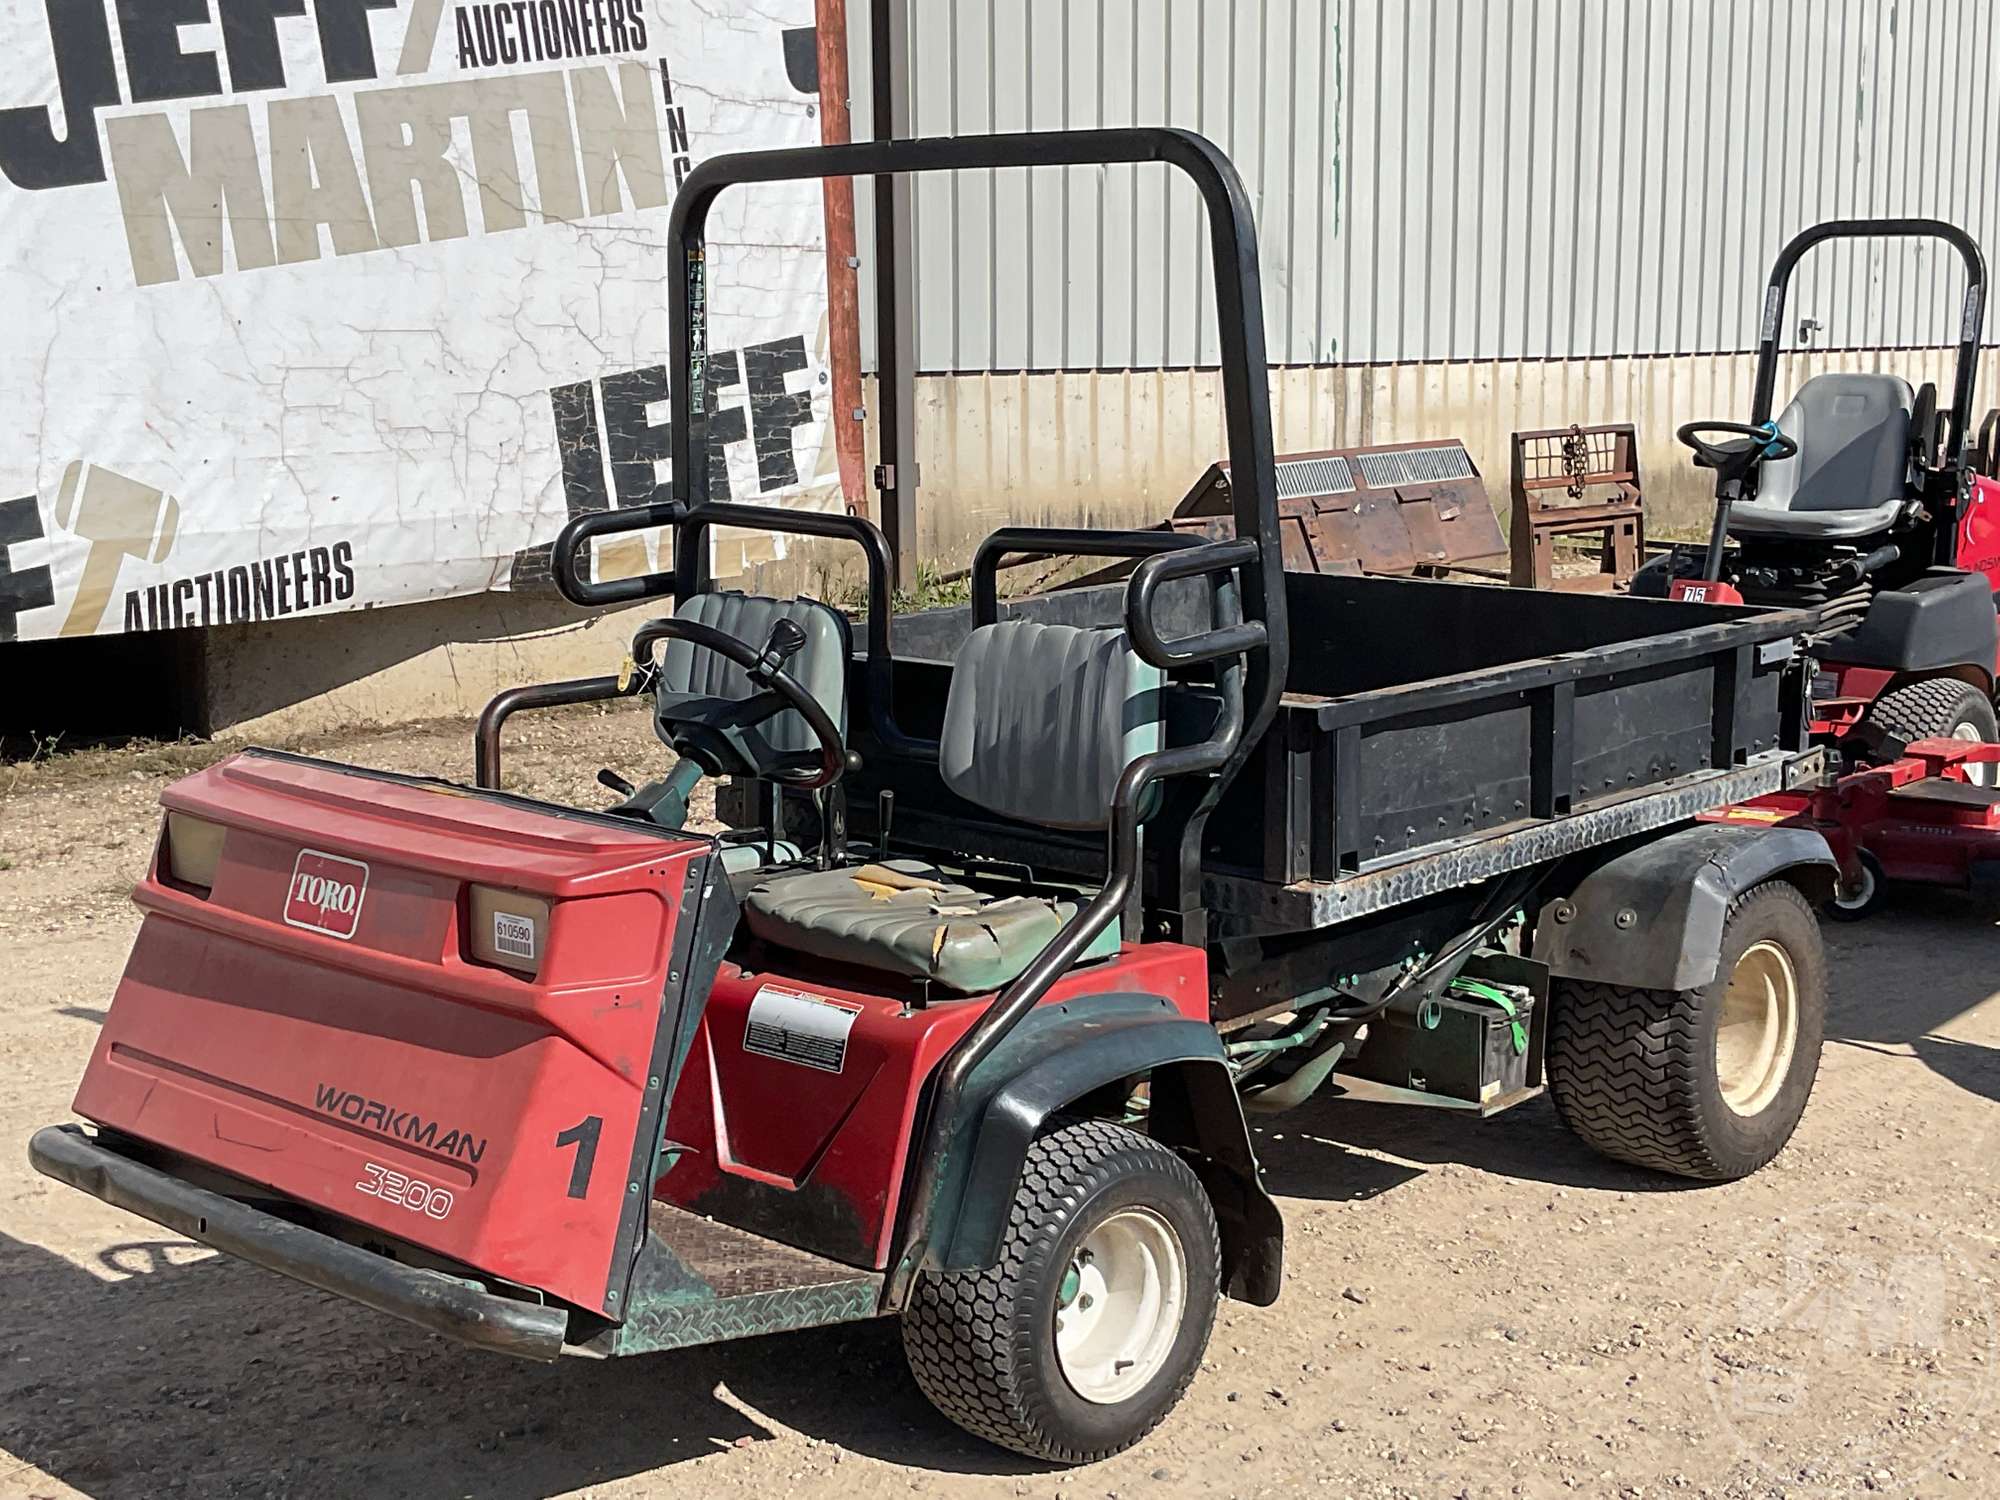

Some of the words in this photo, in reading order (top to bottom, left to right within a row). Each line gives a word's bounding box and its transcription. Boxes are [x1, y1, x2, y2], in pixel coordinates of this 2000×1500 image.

[455, 0, 649, 69] AUCTIONEERS
[106, 61, 669, 287] MARTIN
[124, 541, 355, 633] AUCTIONEERS
[296, 873, 356, 914] TORO
[496, 921, 531, 941] 610590
[315, 1083, 487, 1164] WORKMAN
[555, 1115, 604, 1200] 1
[355, 1162, 454, 1220] 3200
